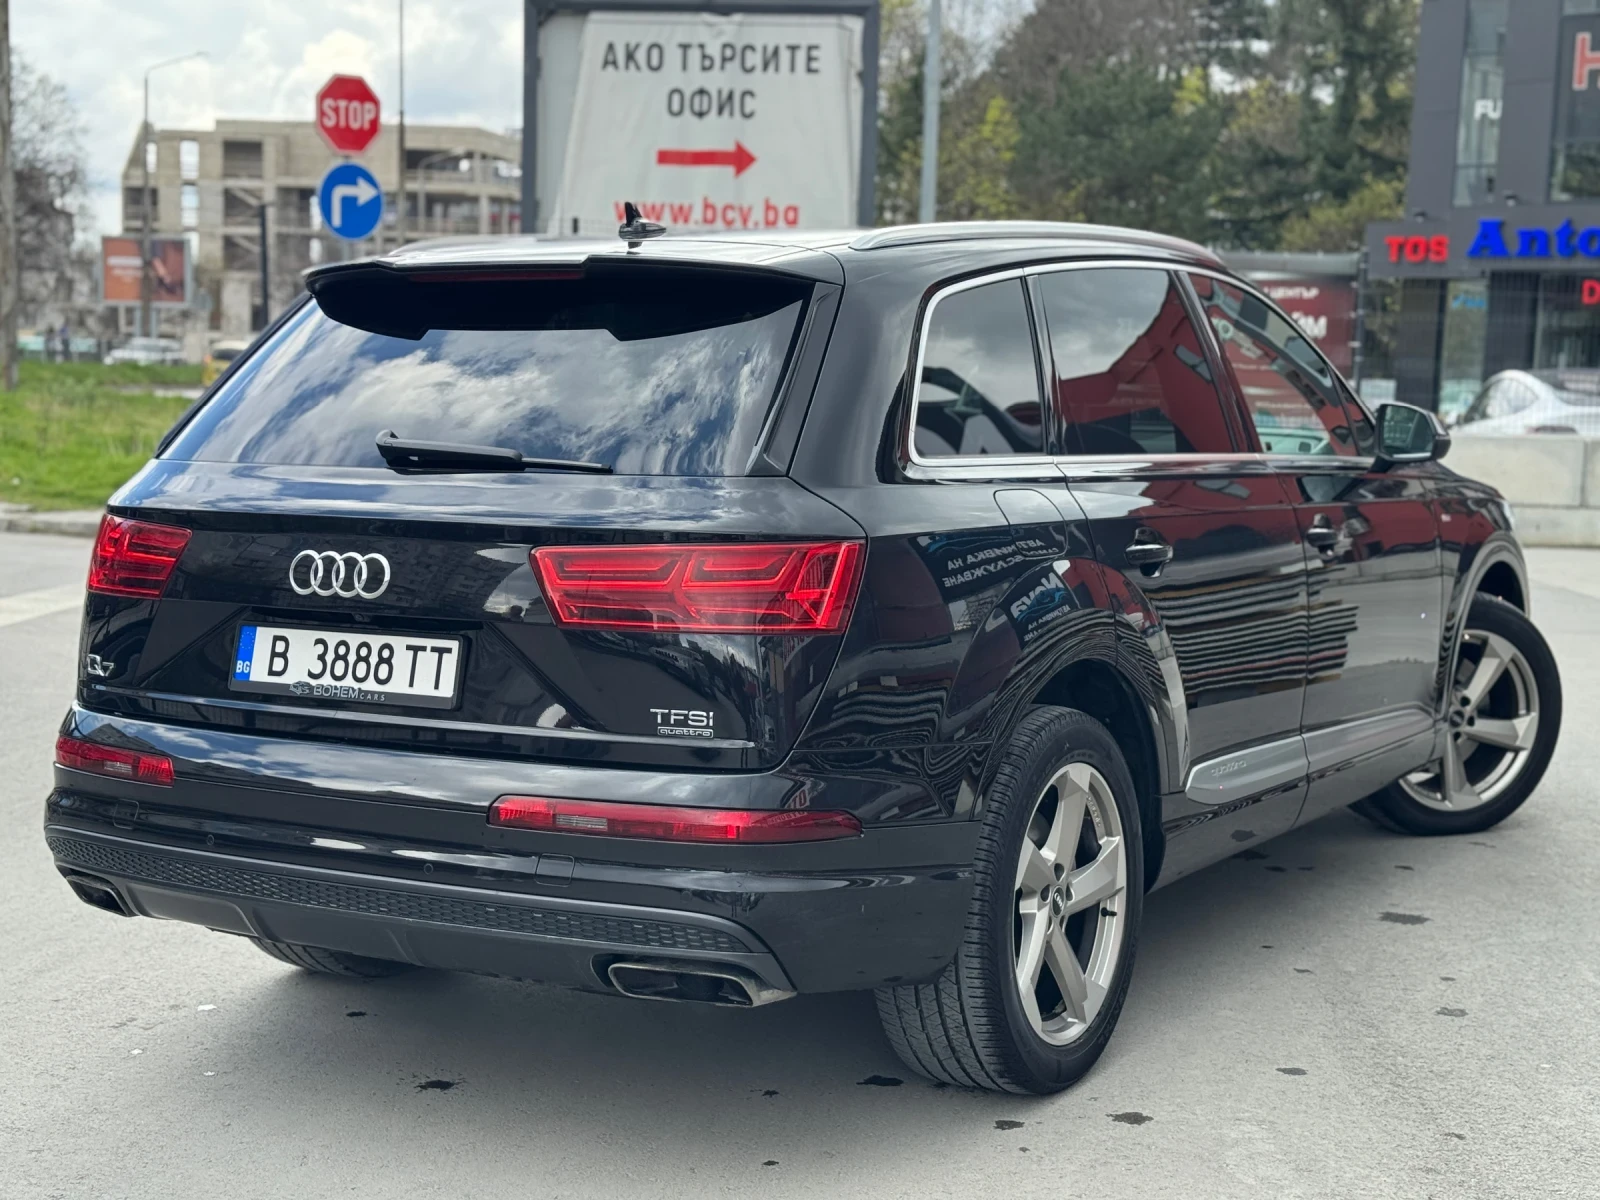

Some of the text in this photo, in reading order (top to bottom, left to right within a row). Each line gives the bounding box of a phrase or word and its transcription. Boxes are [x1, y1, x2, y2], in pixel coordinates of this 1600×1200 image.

[602, 41, 821, 75] АКО ТЪРСИТЕ
[322, 97, 377, 131] STOP
[667, 86, 756, 120] ОФИС
[1384, 235, 1449, 263] TOS
[87, 653, 114, 676] Q7
[235, 660, 250, 673] BG
[267, 634, 453, 690] B 3888 TT
[360, 692, 386, 703] CARS
[659, 728, 711, 737] quattro
